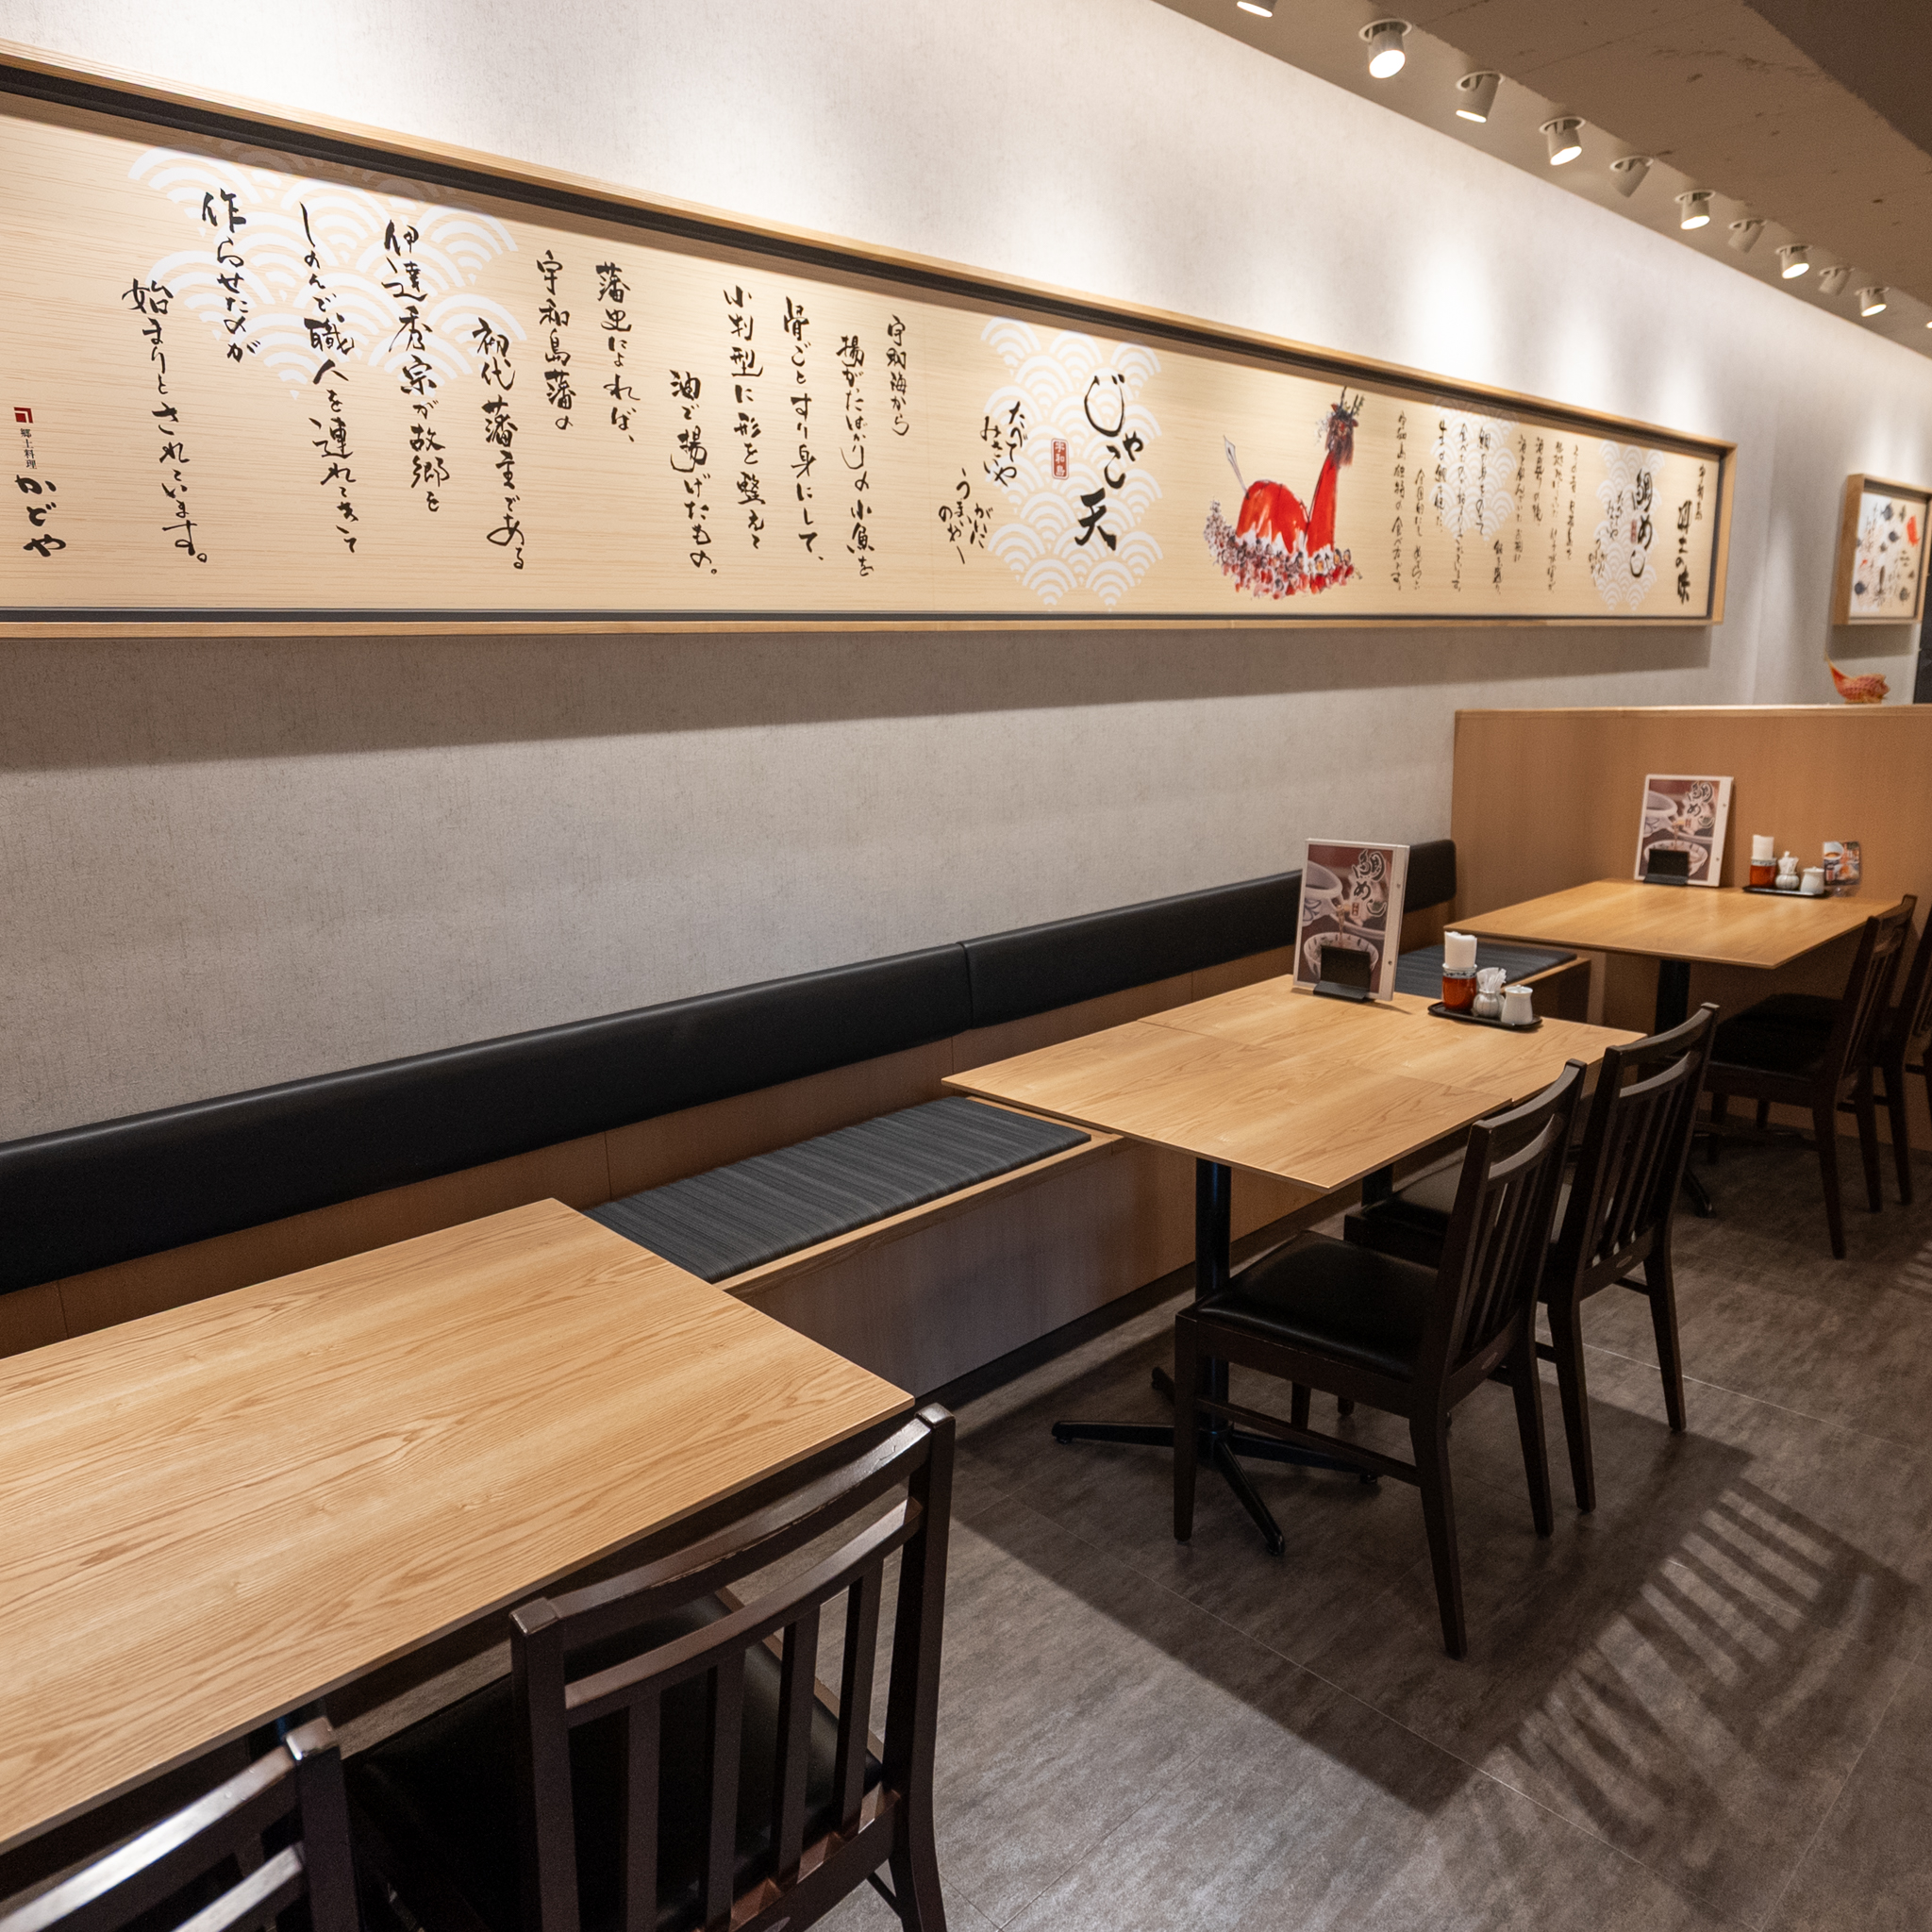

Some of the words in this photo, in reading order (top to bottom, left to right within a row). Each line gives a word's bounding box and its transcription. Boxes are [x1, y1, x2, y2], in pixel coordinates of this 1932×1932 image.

[123, 278, 207, 563] 始まりとされています。
[381, 220, 450, 512] 伊達秀宗が故郷を
[537, 249, 576, 430] 宇和島藩の
[14, 474, 67, 558] かどや
[20, 427, 38, 470] 郷土料理
[472, 317, 525, 570] 初代藩主である
[1074, 374, 1144, 551] じゃこ天
